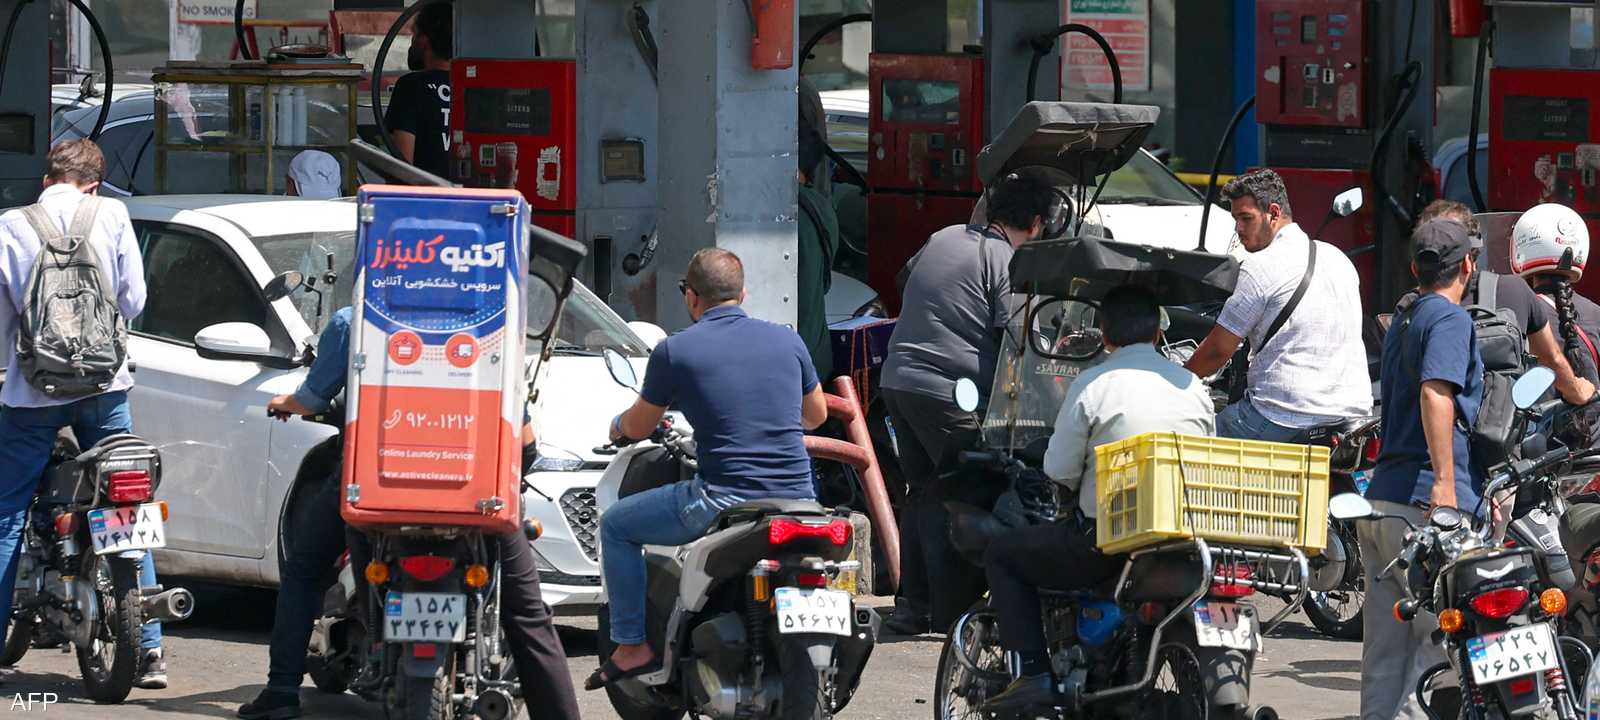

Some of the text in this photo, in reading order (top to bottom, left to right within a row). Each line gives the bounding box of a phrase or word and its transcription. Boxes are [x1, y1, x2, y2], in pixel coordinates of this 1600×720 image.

[183, 6, 254, 17] NO SMOKG
[370, 235, 505, 272] اکتیو کلینرز
[372, 274, 501, 292] سرویس خشکشویی آنلاین
[406, 412, 474, 430] ۹۲۰۰۱۲۱۲
[379, 448, 474, 460] Online Laundry Service
[116, 509, 151, 526] ۱۵۸
[416, 597, 453, 613] ۱۵۸
[1496, 631, 1537, 651] ۳۲۹
[1478, 651, 1547, 678] ۷۶۵۴۷
